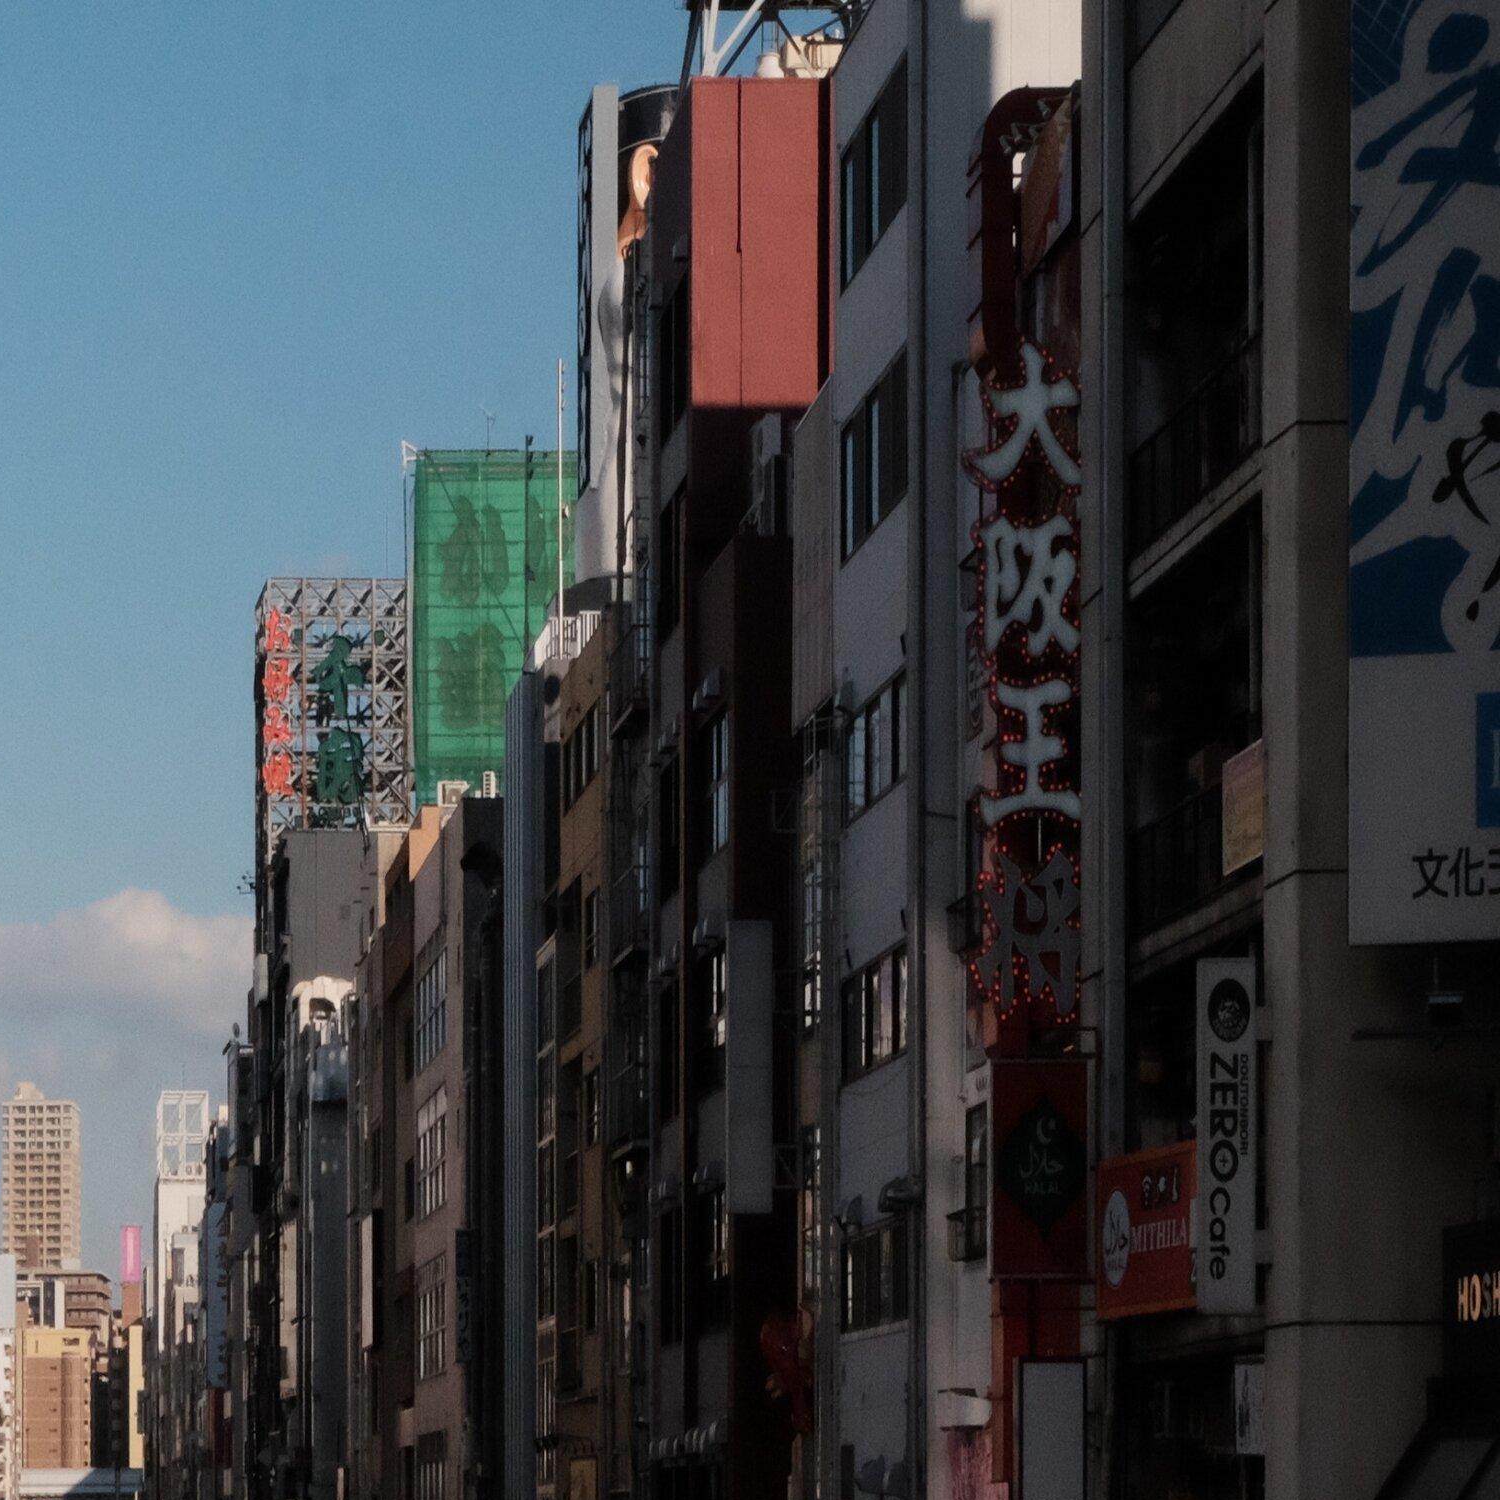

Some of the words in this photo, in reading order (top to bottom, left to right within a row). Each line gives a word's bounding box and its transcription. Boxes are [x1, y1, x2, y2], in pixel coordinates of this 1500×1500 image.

[975, 344, 1083, 1018] 大阪王将
[1209, 1052, 1239, 1183] ZERO
[1240, 1054, 1250, 1156] DOUTONBORI
[1024, 1181, 1062, 1196] HALAL
[1130, 1216, 1188, 1254] MITHILA
